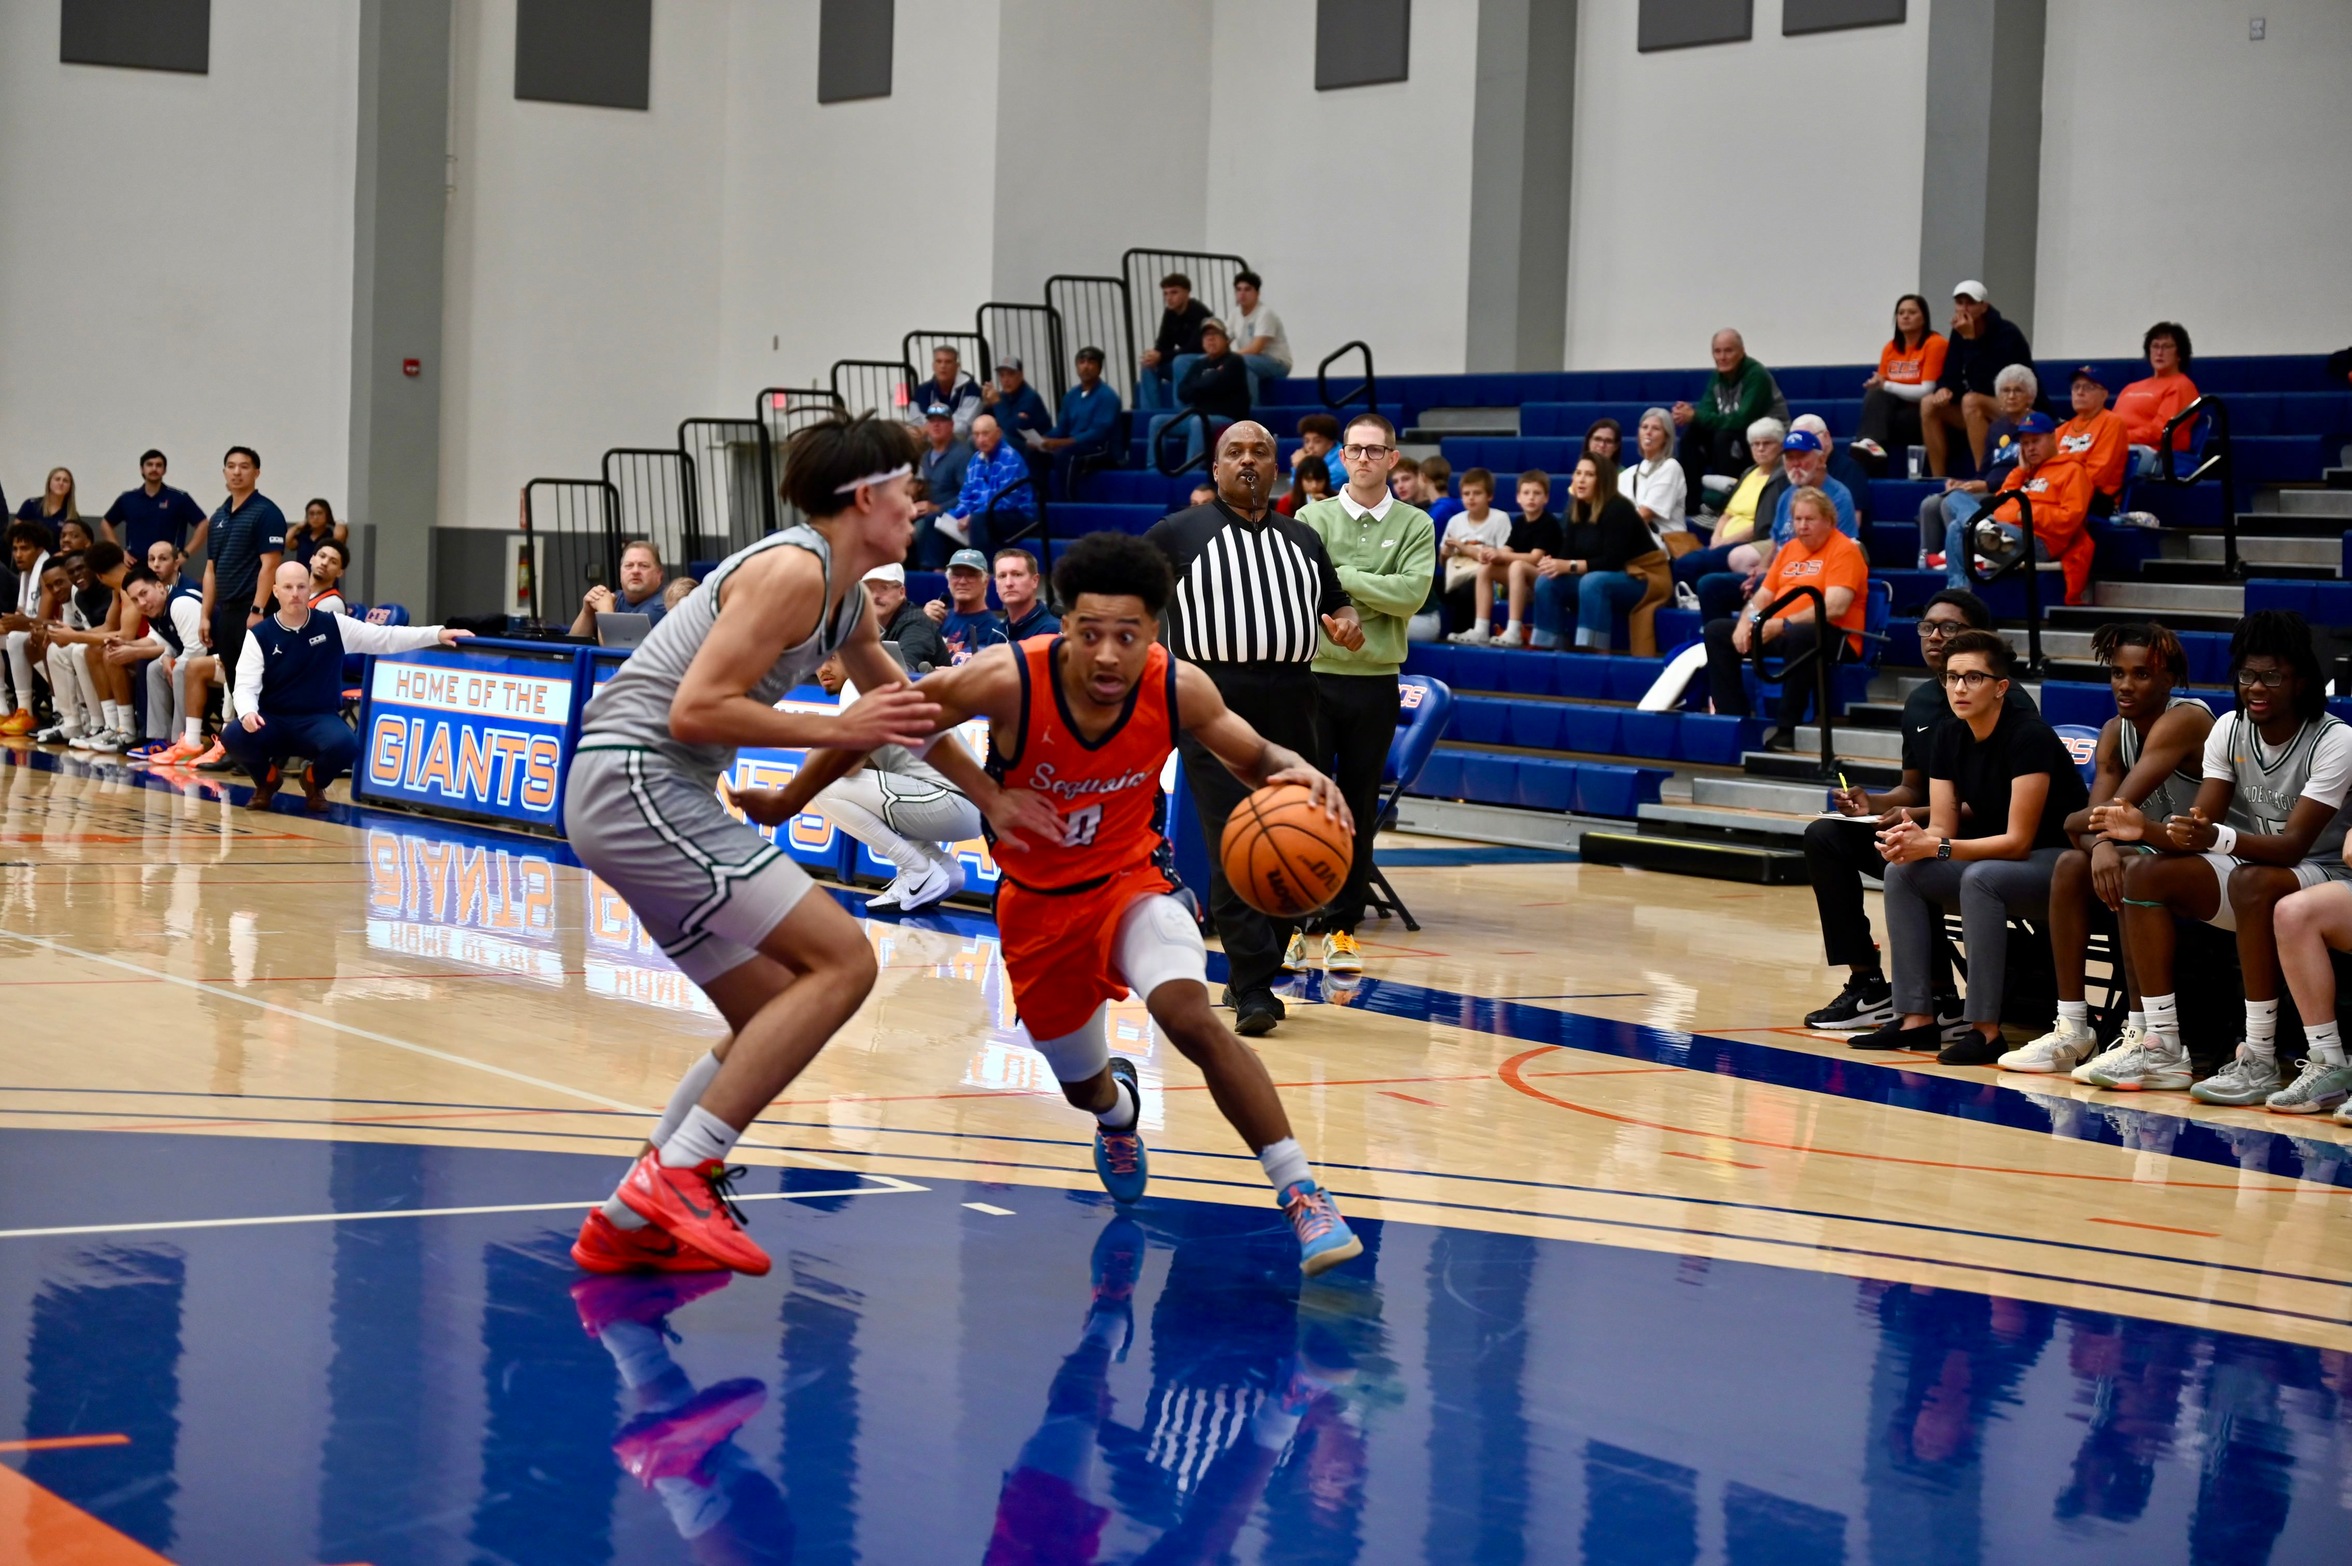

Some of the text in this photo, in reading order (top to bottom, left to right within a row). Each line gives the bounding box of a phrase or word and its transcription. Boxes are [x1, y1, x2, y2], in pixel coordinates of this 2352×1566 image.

[396, 670, 548, 715] HOME OF THE
[369, 713, 560, 812] GIANTS
